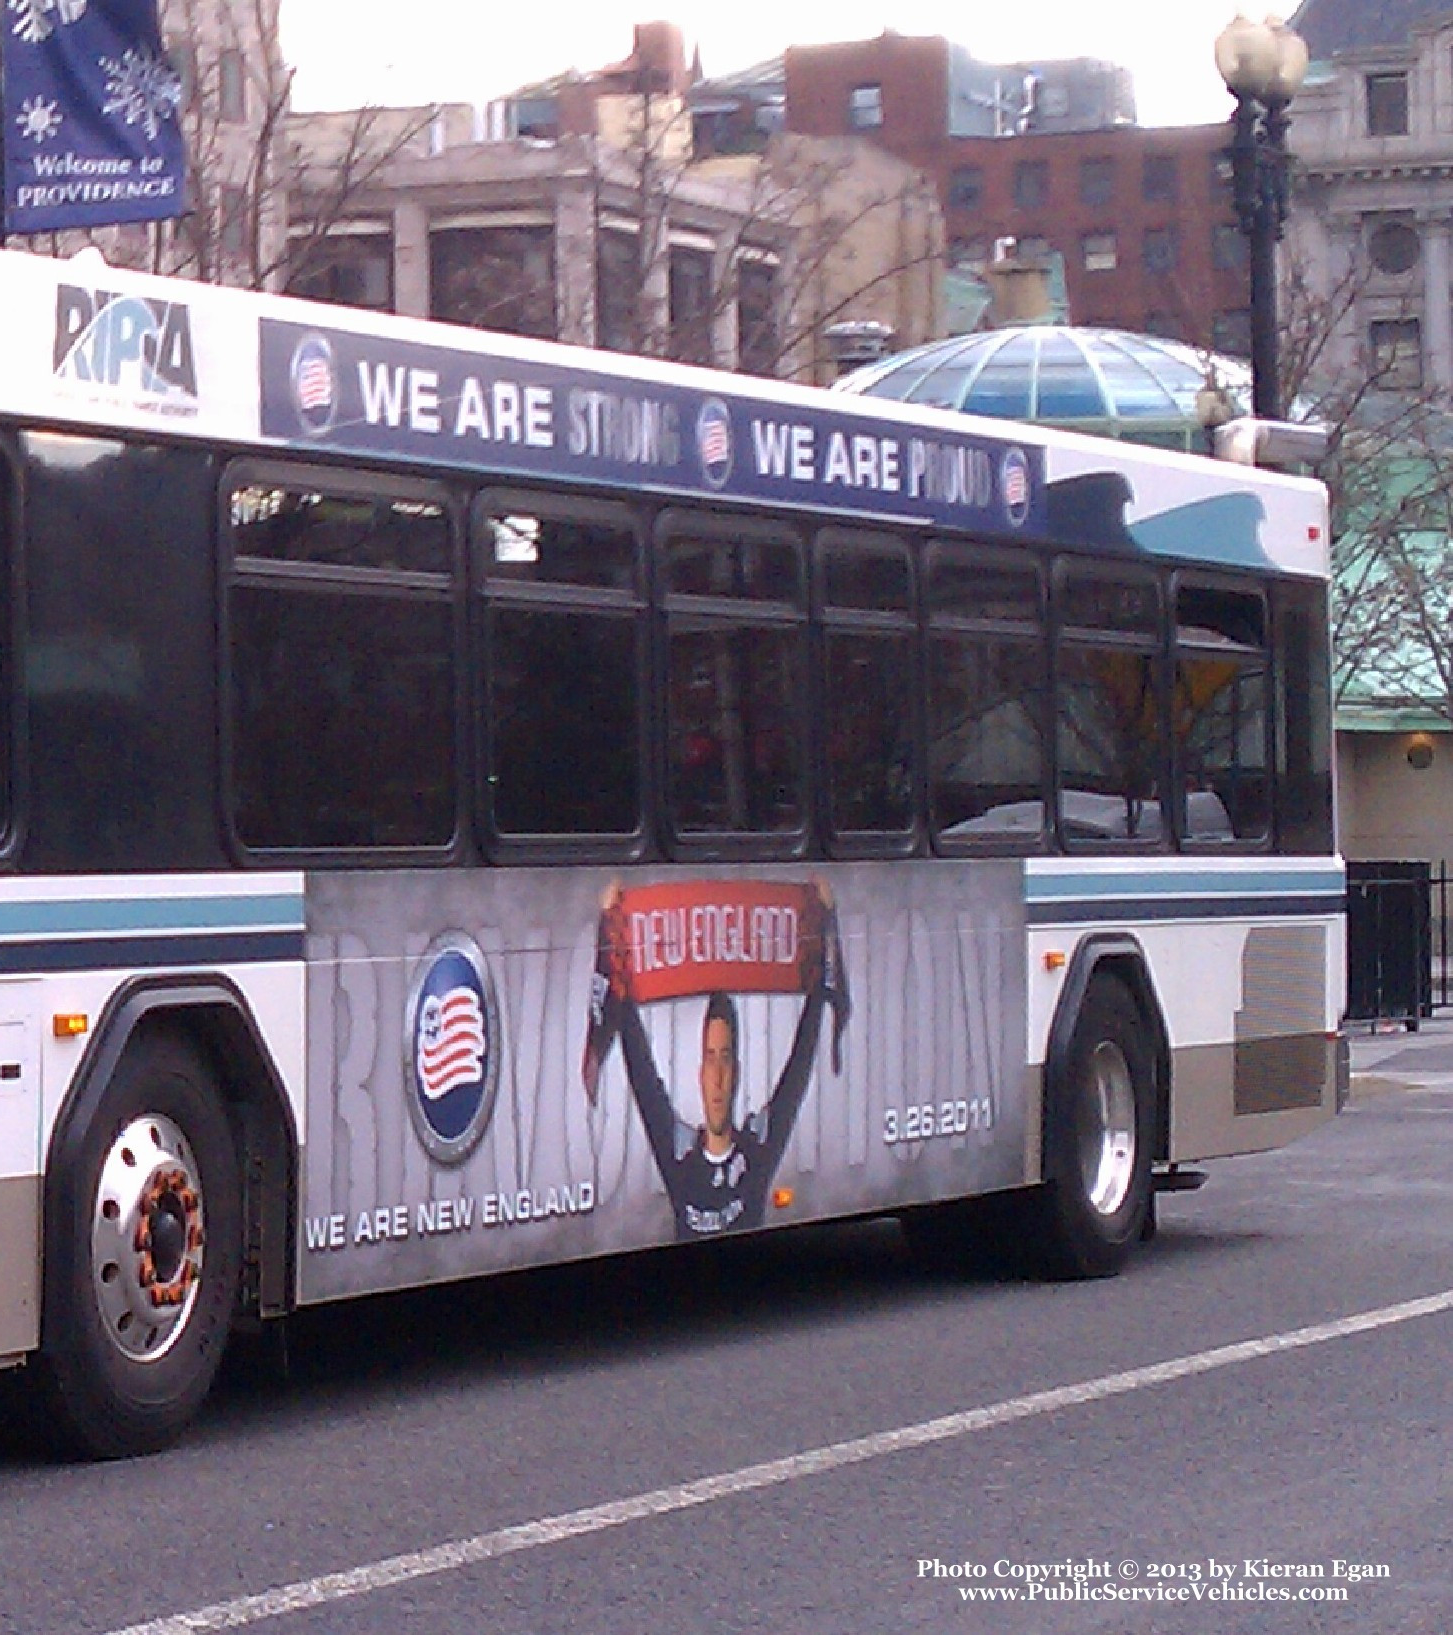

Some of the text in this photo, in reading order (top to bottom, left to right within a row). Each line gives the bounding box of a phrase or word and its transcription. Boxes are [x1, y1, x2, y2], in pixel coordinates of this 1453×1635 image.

[17, 176, 176, 207] PROVIDENCE
[33, 153, 164, 176] Welcome to
[53, 283, 198, 397] RIPTA
[356, 359, 681, 466] WE ARE STRONG
[752, 420, 991, 506] WE ARE PROUD
[631, 904, 796, 974] NEW ENGLAND
[883, 1097, 992, 1142] 3.26.2011
[305, 1181, 594, 1249] WE ARE NEW ENGLAND
